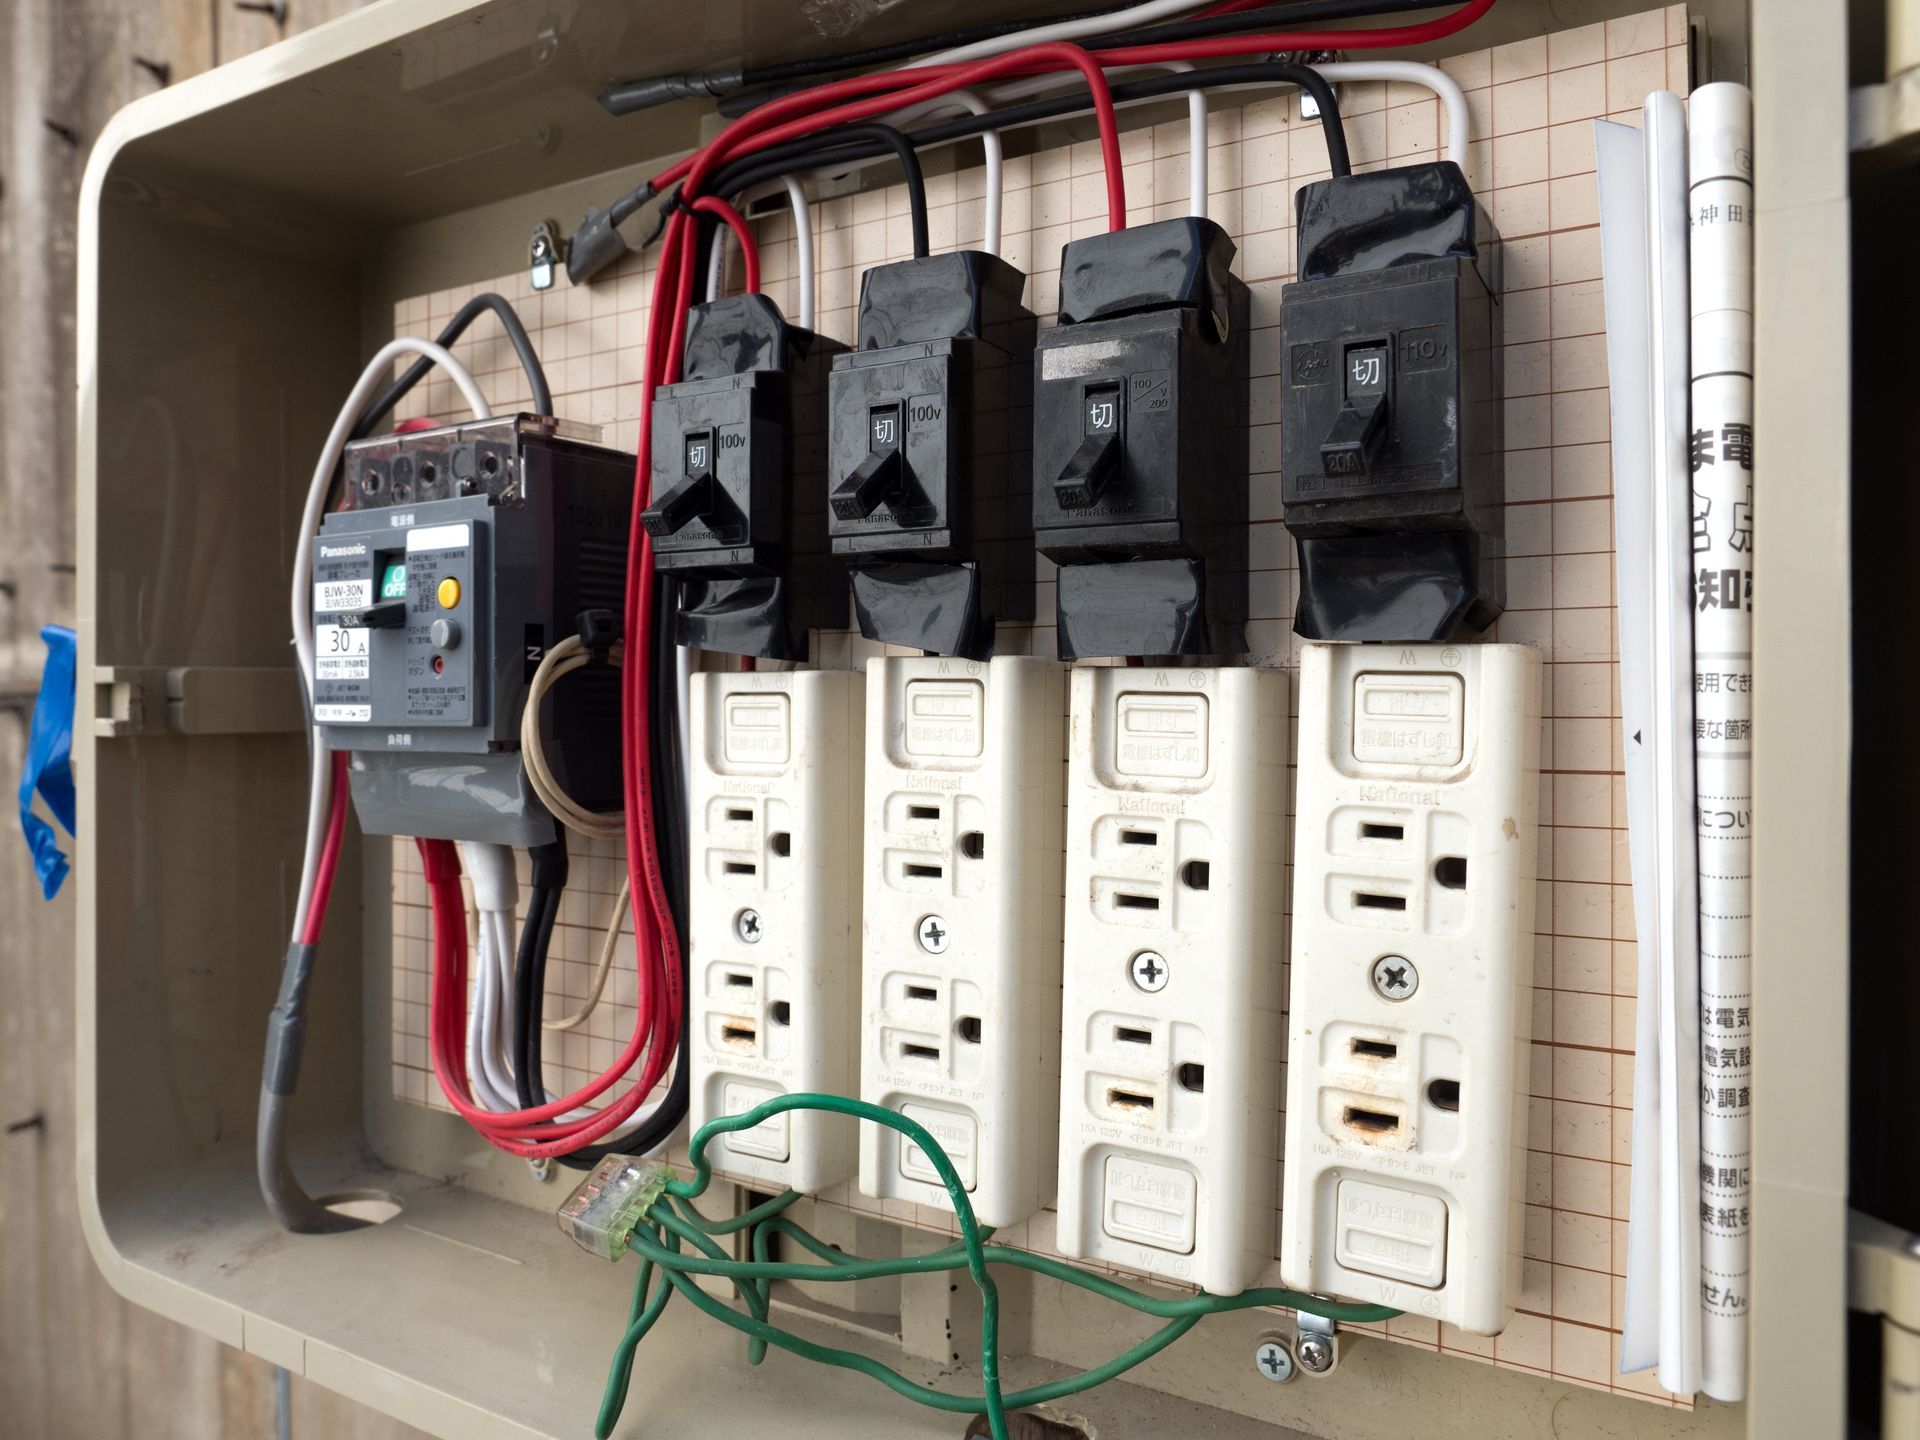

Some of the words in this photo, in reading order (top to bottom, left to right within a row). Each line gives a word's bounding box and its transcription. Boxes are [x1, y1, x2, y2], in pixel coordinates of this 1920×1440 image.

[1690, 204, 1752, 227] 神田
[1352, 358, 1379, 385] 切
[1133, 380, 1152, 389] 100
[1149, 399, 1168, 409] 200
[1090, 403, 1113, 429] 切
[874, 419, 894, 443] 切
[689, 445, 706, 468] 切
[1327, 453, 1361, 473] 20A
[321, 543, 366, 557] Panasonic
[384, 581, 406, 597] OFF
[343, 615, 360, 626] 30A
[330, 630, 351, 652] 30
[357, 642, 366, 654] A
[906, 775, 963, 790] National
[1118, 796, 1186, 814] National
[1360, 785, 1441, 806] National
[1702, 1006, 1751, 1029] は電気
[948, 1087, 964, 1098] JET
[1100, 1126, 1122, 1140] 125V
[1165, 1139, 1184, 1152] JET
[1336, 1147, 1361, 1162] 125V
[1414, 1162, 1437, 1177] JET
[930, 1191, 942, 1203] W
[1700, 1200, 1750, 1229] 表紙を
[1139, 1251, 1154, 1267] W
[1380, 1286, 1396, 1301] W
